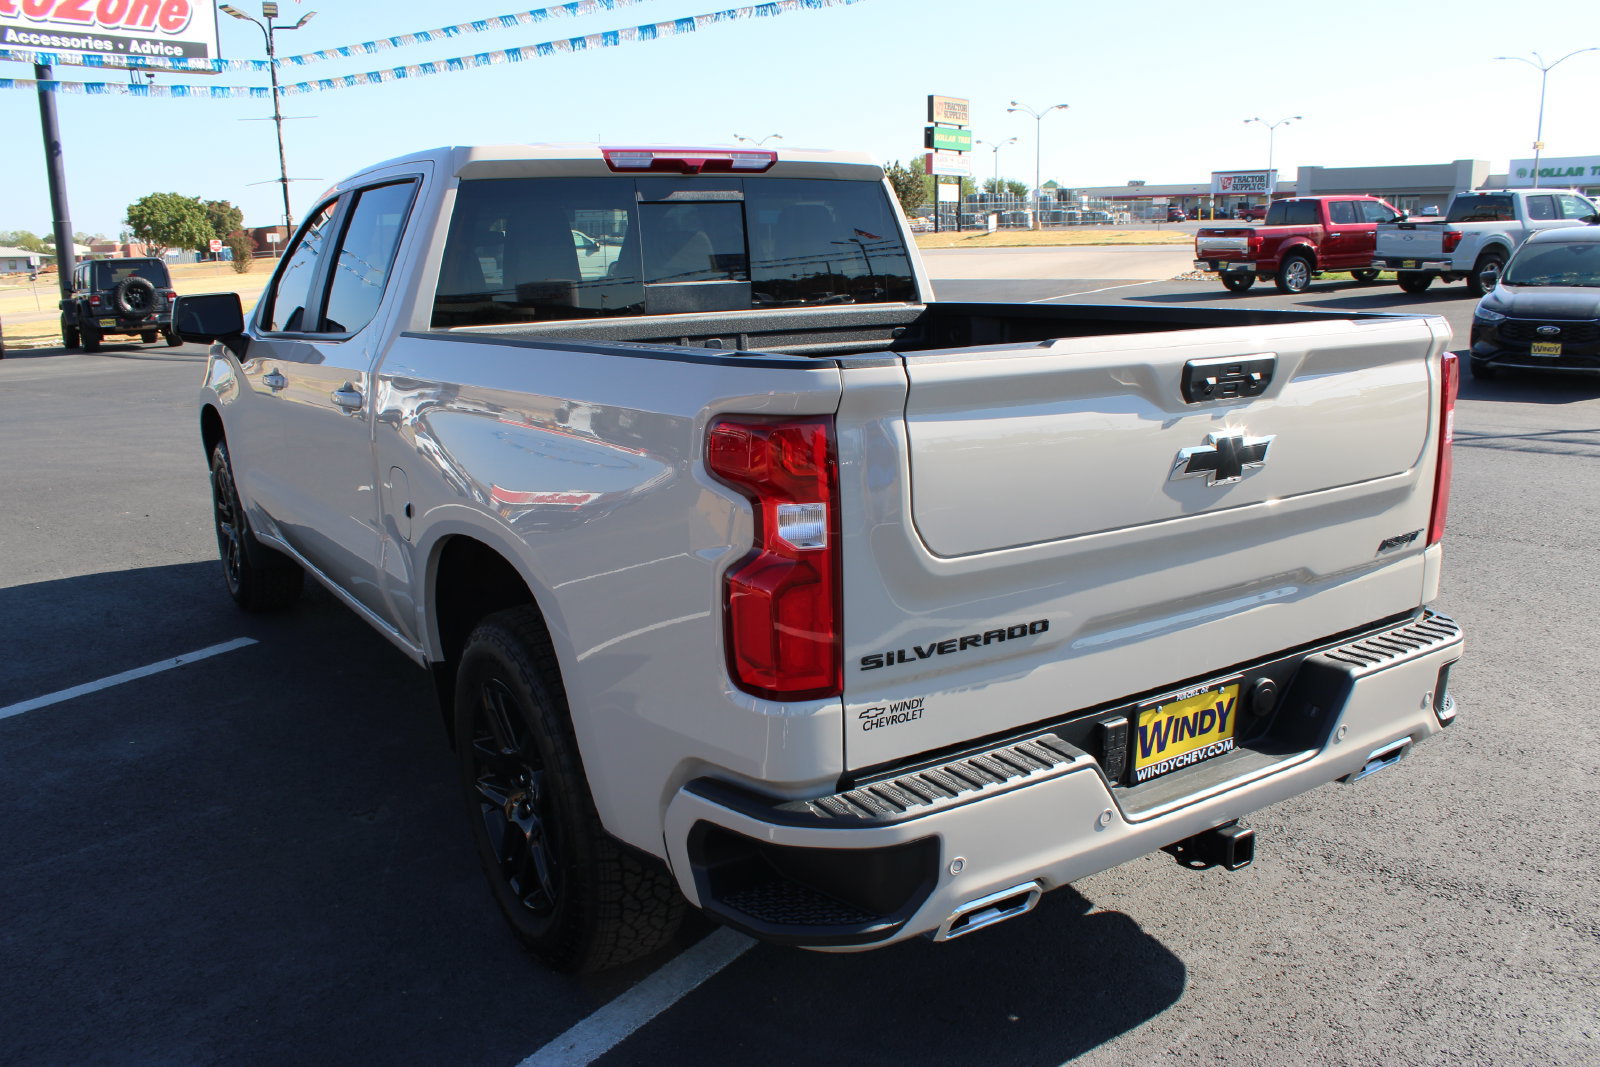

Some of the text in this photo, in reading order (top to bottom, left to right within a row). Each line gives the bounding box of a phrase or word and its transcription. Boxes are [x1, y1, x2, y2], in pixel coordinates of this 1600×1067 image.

[6, 29, 183, 56] Accessories Advice
[944, 102, 968, 112] TRACTOR
[1232, 175, 1265, 183] TRACTOR
[1530, 166, 1585, 178] DOLLAR
[1533, 345, 1560, 353] WINDY
[860, 618, 1049, 671] SILVERADO
[889, 697, 924, 714] WINDY
[862, 708, 925, 731] CHEVROLET
[1138, 697, 1236, 759] WINDY
[1136, 739, 1234, 782] WINDYCHEV.COM
